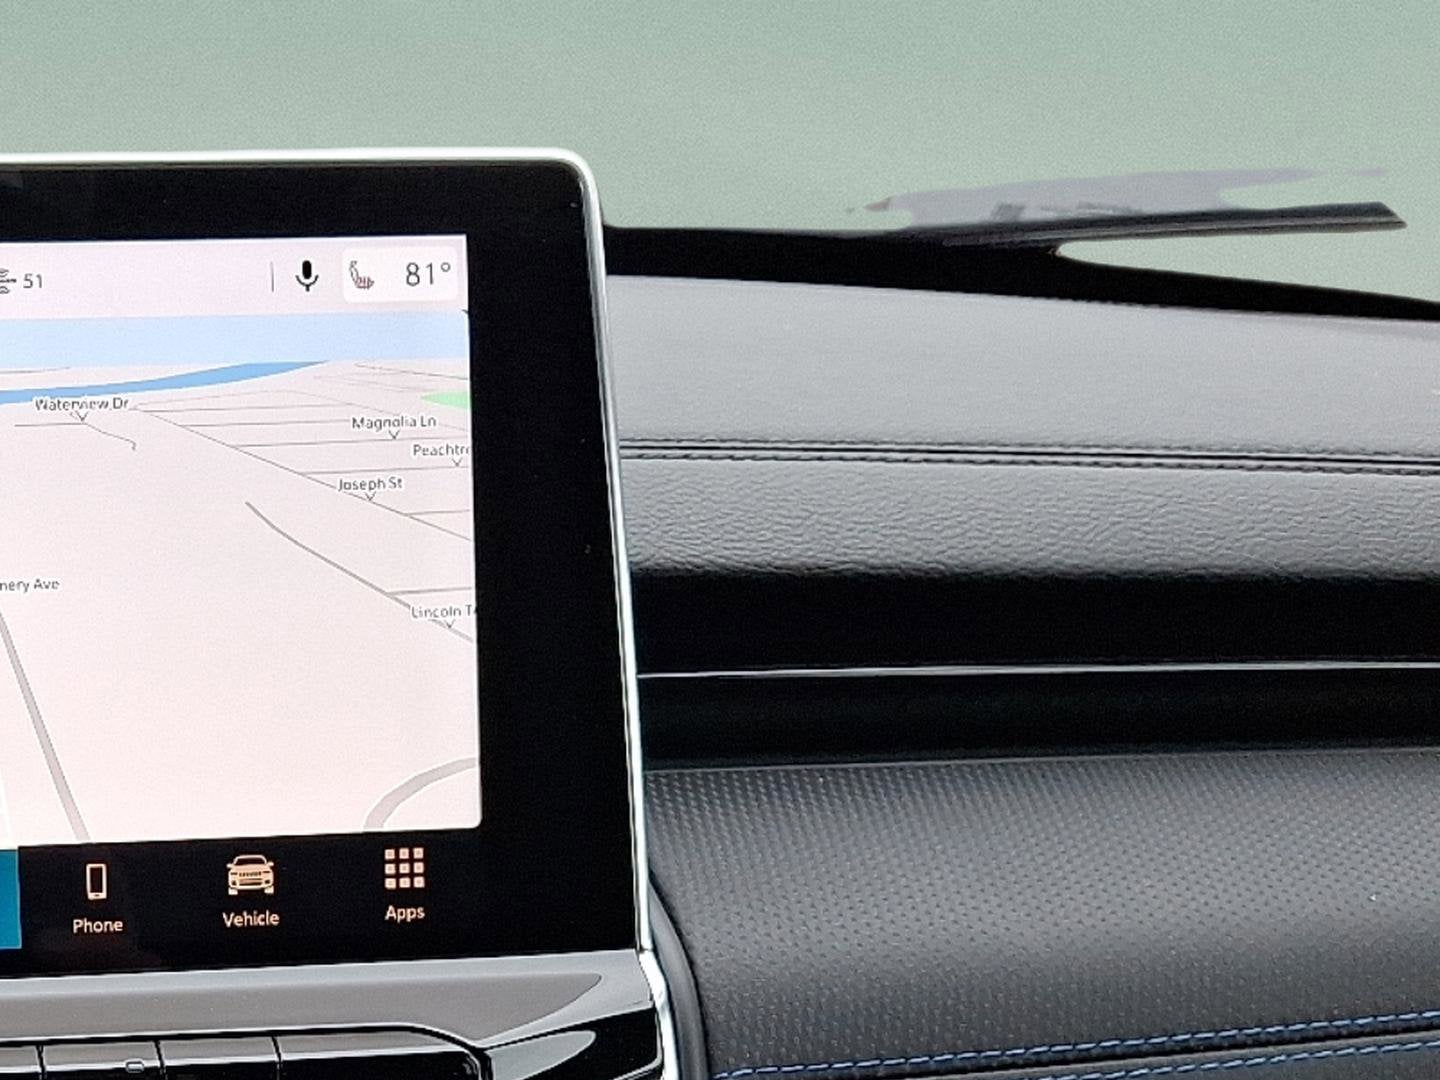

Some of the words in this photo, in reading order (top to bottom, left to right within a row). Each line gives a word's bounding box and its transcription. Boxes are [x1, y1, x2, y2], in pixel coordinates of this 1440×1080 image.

[24, 274, 42, 288] 51
[406, 263, 450, 286] 81°
[112, 396, 129, 410] Dr
[352, 416, 416, 432] Magnolia
[421, 416, 436, 427] Ln
[337, 478, 387, 492] Joseph
[389, 477, 402, 489] St
[33, 578, 60, 590] Ave
[411, 606, 462, 618] Lincoln
[223, 910, 279, 927] Vehicle
[385, 906, 425, 922] Apps
[74, 918, 123, 933] Phone
